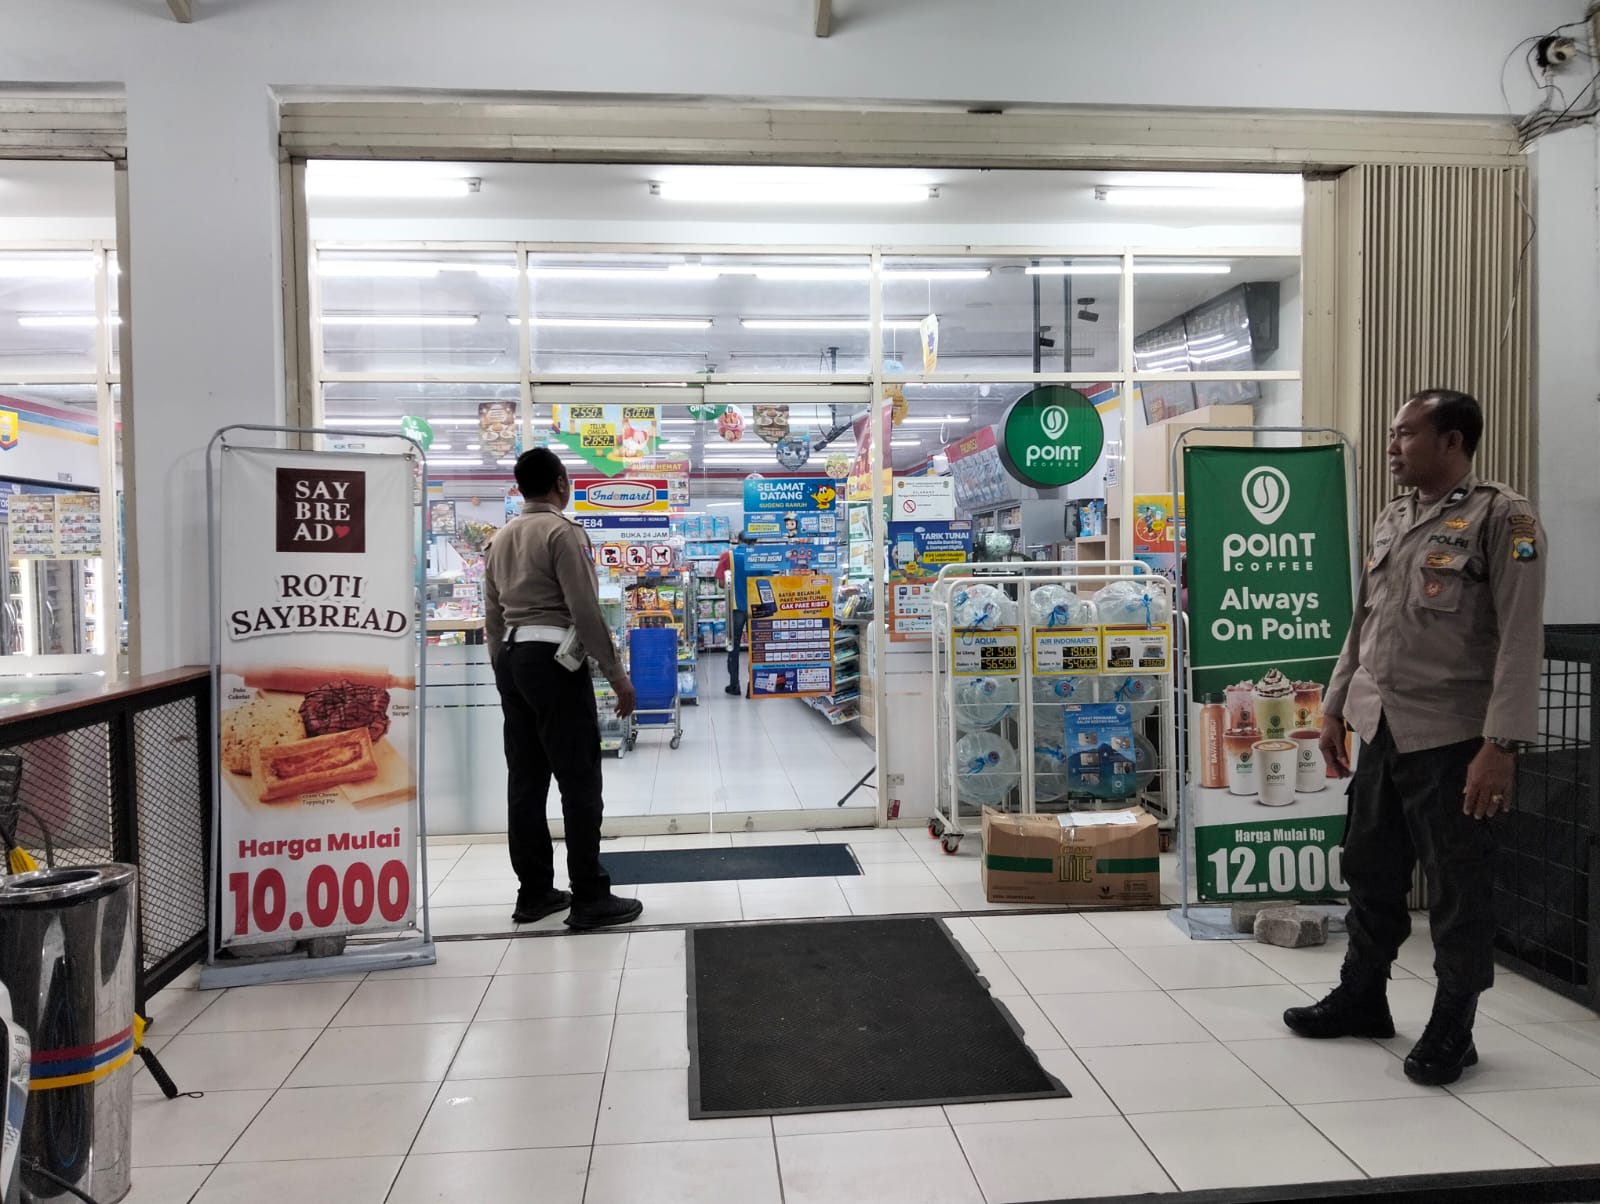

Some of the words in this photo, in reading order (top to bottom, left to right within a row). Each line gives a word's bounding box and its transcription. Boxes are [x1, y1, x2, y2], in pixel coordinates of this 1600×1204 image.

[295, 480, 351, 500] SAY
[590, 490, 651, 501] Indomaret
[757, 482, 806, 491] SELAMAT
[760, 492, 802, 500] DATANG
[295, 502, 351, 522] BRE
[293, 523, 334, 542] AD
[1428, 534, 1468, 548] POLRI
[1235, 562, 1313, 572] COFFEE
[280, 575, 363, 599] ROTI
[1220, 586, 1319, 616] Always
[231, 606, 407, 636] SAYBREAD
[1211, 618, 1252, 641] On
[1262, 617, 1331, 640] Point
[238, 834, 322, 860] Harga
[327, 828, 400, 852] Mulai
[1235, 829, 1271, 844] Harga
[1273, 828, 1307, 841] Mulai
[1310, 828, 1325, 843] Rp
[228, 860, 410, 936] 10.000
